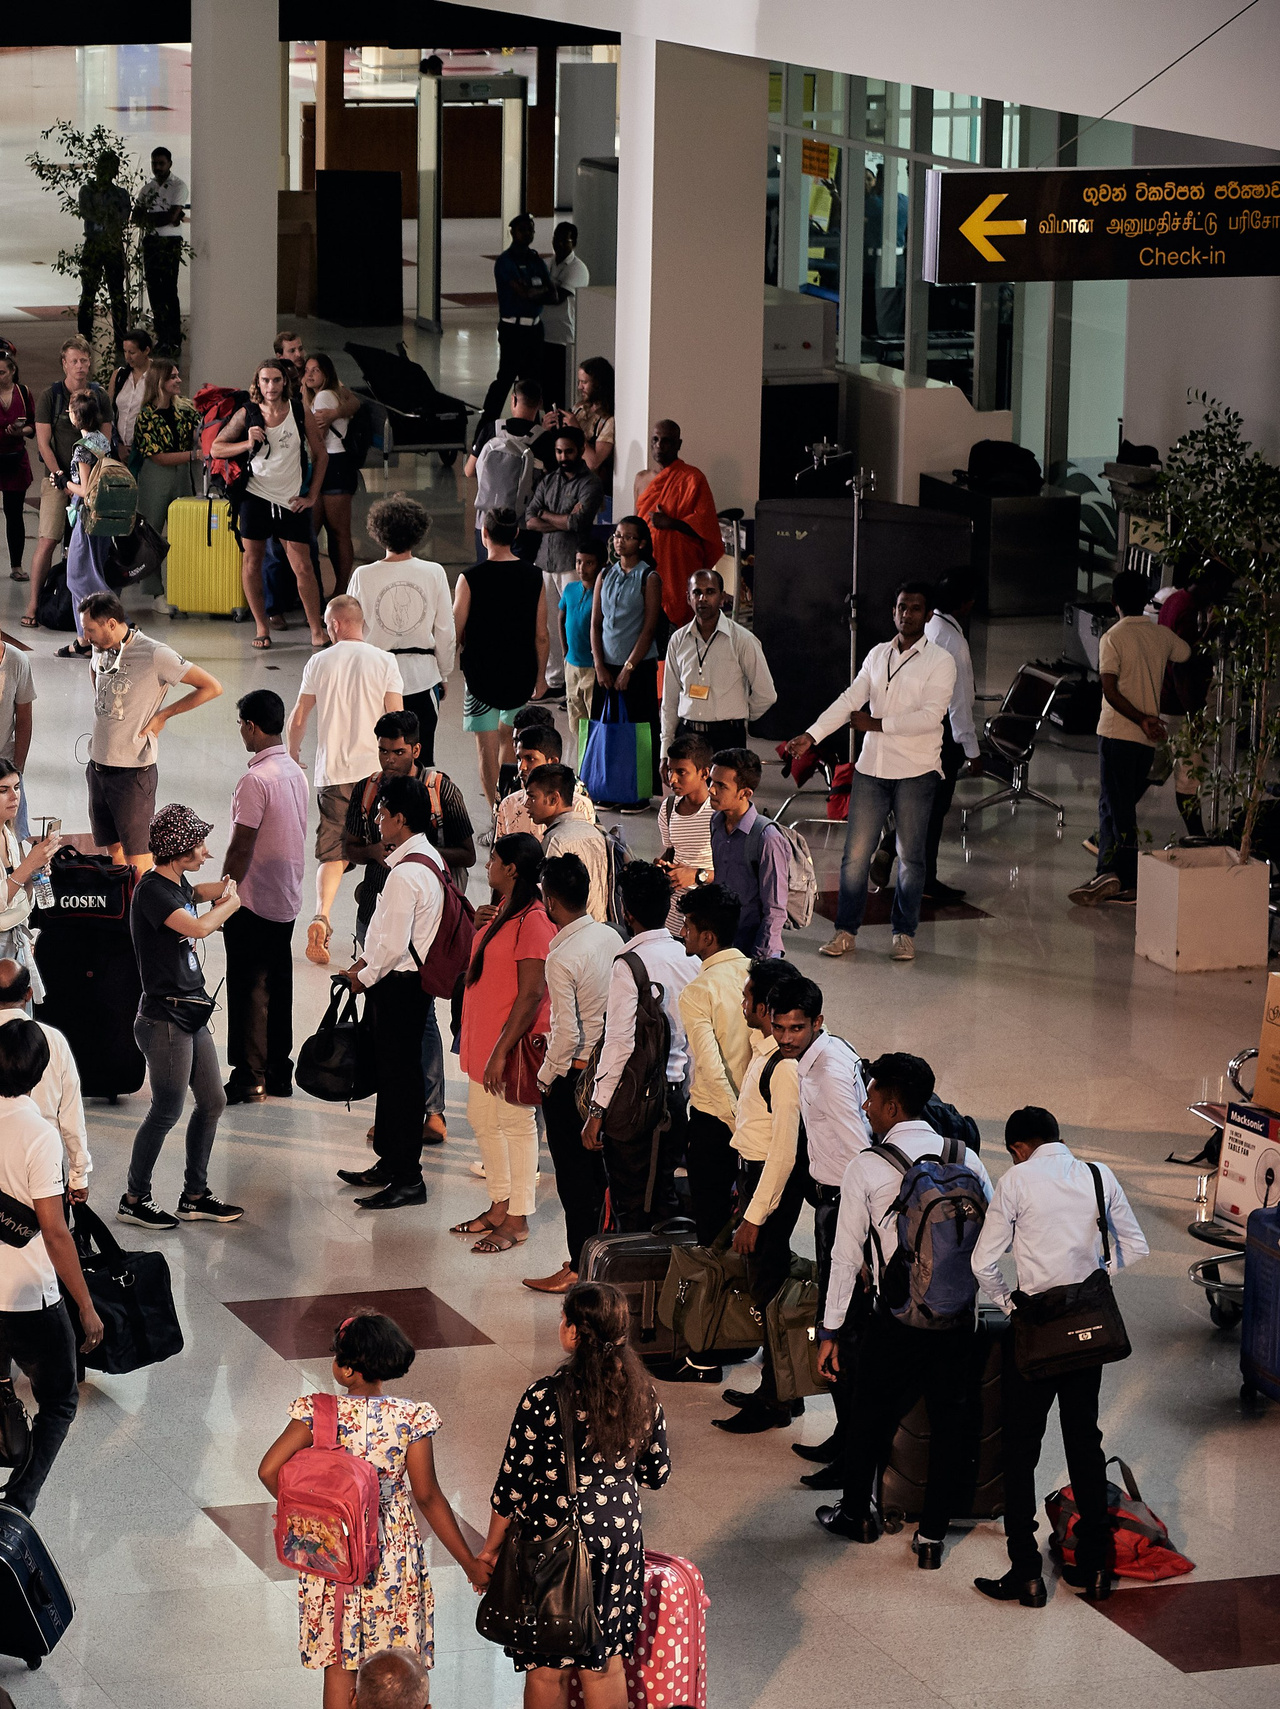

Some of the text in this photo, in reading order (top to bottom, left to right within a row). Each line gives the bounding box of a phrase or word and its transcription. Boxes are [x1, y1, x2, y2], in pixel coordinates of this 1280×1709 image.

[1083, 183, 1127, 206] ගුවන්
[1038, 212, 1094, 234] விமான
[1139, 245, 1226, 266] Check-in
[60, 895, 107, 909] GOSEN
[1231, 1110, 1263, 1132] Macksonic
[1228, 1142, 1240, 1153] TABLE
[182, 1202, 197, 1210] KLEIN
